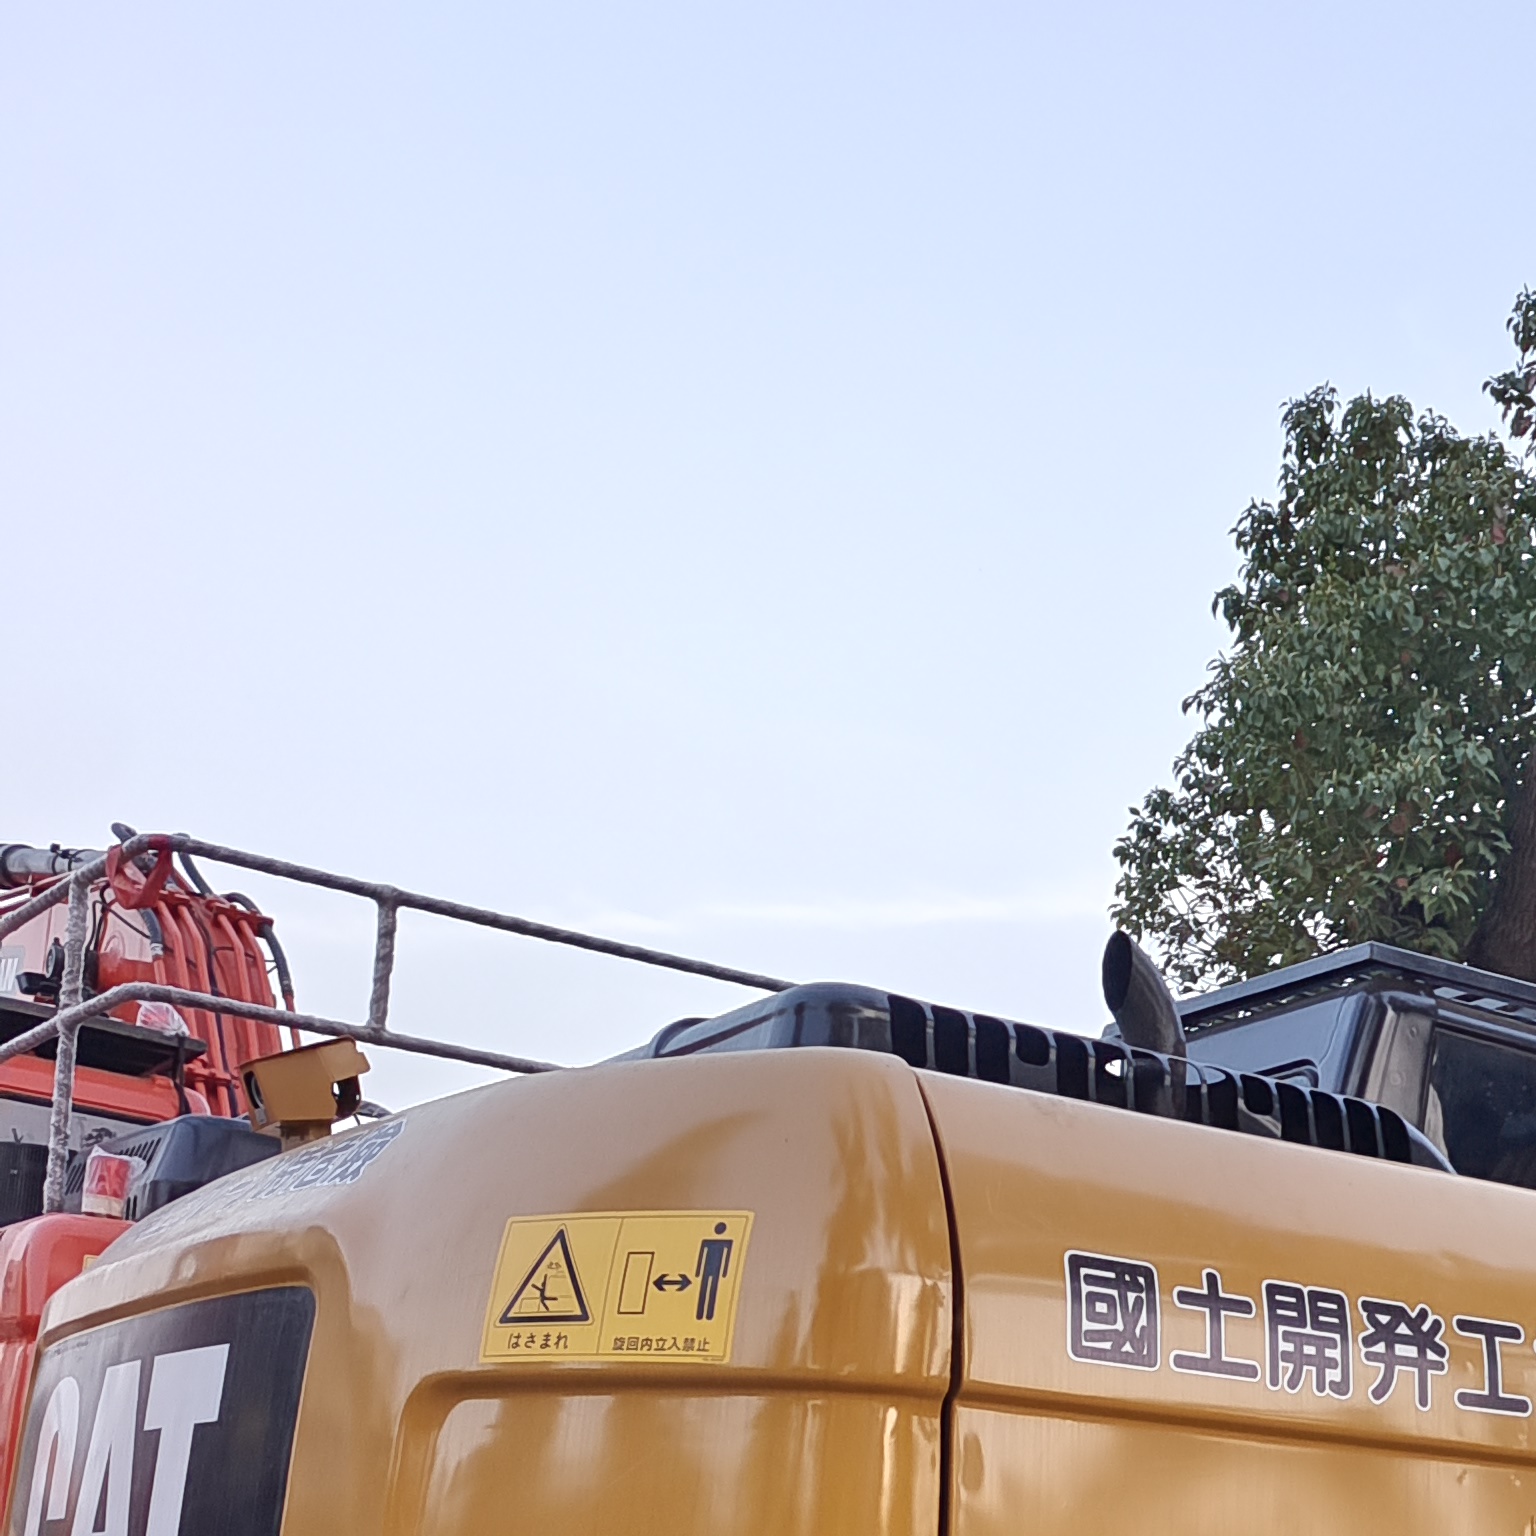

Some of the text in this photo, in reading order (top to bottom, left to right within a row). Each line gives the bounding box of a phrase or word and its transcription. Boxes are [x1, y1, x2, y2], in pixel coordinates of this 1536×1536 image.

[506, 1331, 570, 1350] はさまれ
[611, 1335, 712, 1353] 旋回内立入禁止
